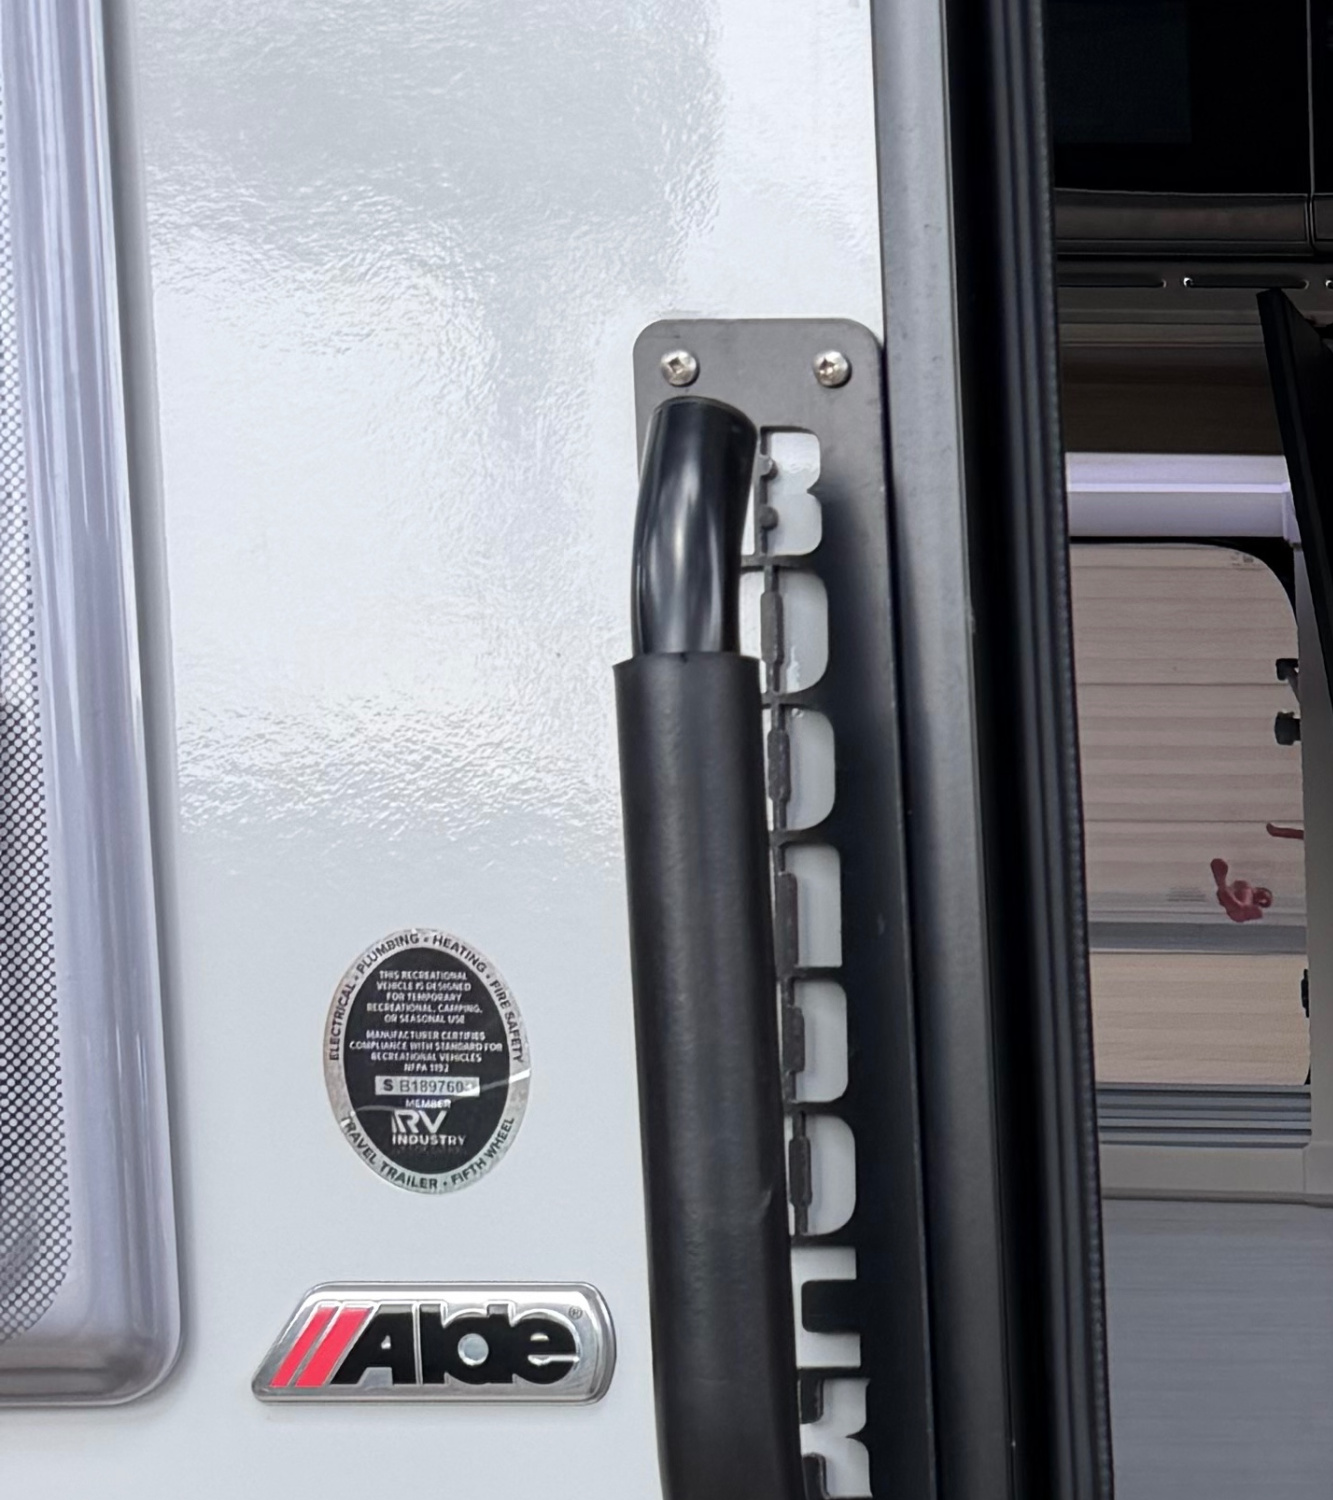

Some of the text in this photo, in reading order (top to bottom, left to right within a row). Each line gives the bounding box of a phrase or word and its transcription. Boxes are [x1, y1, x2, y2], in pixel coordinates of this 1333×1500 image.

[379, 970, 467, 981] THIS RECREATIONAL
[376, 981, 472, 992] VEHICLE IS DESIGNED
[329, 933, 525, 1063] ELECTRICAL PLUMBING HEATING FIRE SAFETY
[386, 992, 462, 1002] FOR TEMPORARY
[384, 1014, 466, 1024] OR SEASONAL USE
[366, 1030, 440, 1040] MANUFACTURER
[349, 1041, 503, 1052] COMPLIANCE WITH STANDARD FOR
[370, 1052, 482, 1063] RECREATIONAL VEHICLES
[383, 1079, 393, 1092] S
[405, 1098, 452, 1109] MEMBER
[391, 1109, 448, 1134] RV
[392, 1134, 467, 1146] INDUSTRY
[340, 1116, 515, 1189] TRAVEL TRAILER FIFTH WHEEL
[330, 1302, 576, 1385] Alde
